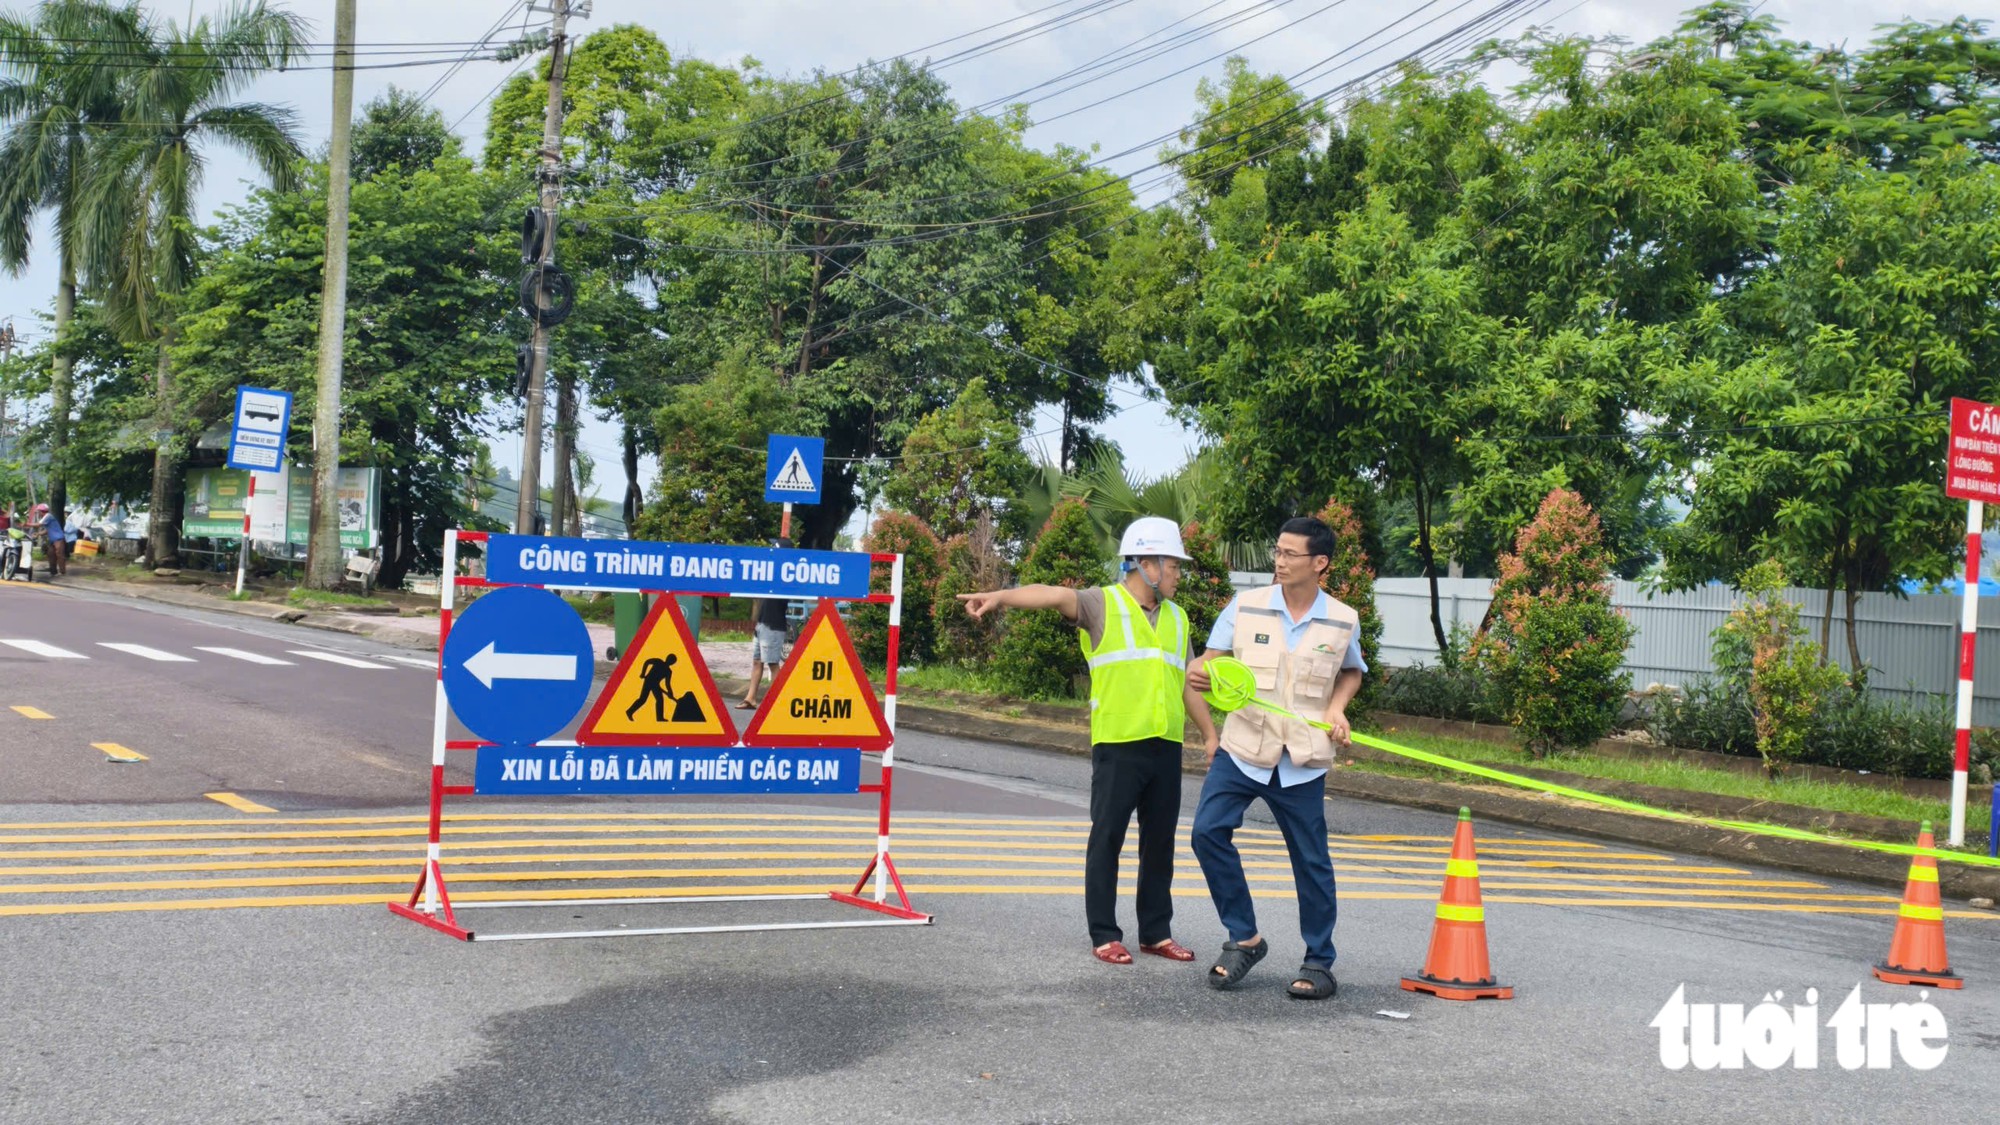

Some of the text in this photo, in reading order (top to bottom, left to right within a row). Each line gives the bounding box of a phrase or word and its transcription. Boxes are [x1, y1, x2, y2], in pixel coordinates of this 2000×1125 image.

[1969, 406, 2000, 435] CẤM
[519, 543, 840, 585] CÔNG TRÌNH ĐANG THI CÔNG
[812, 660, 833, 681] ĐI
[790, 694, 852, 724] CHẬM
[501, 751, 839, 786] XIN LỖI ĐÃ LÀM PHIỀN CÁC BẠN
